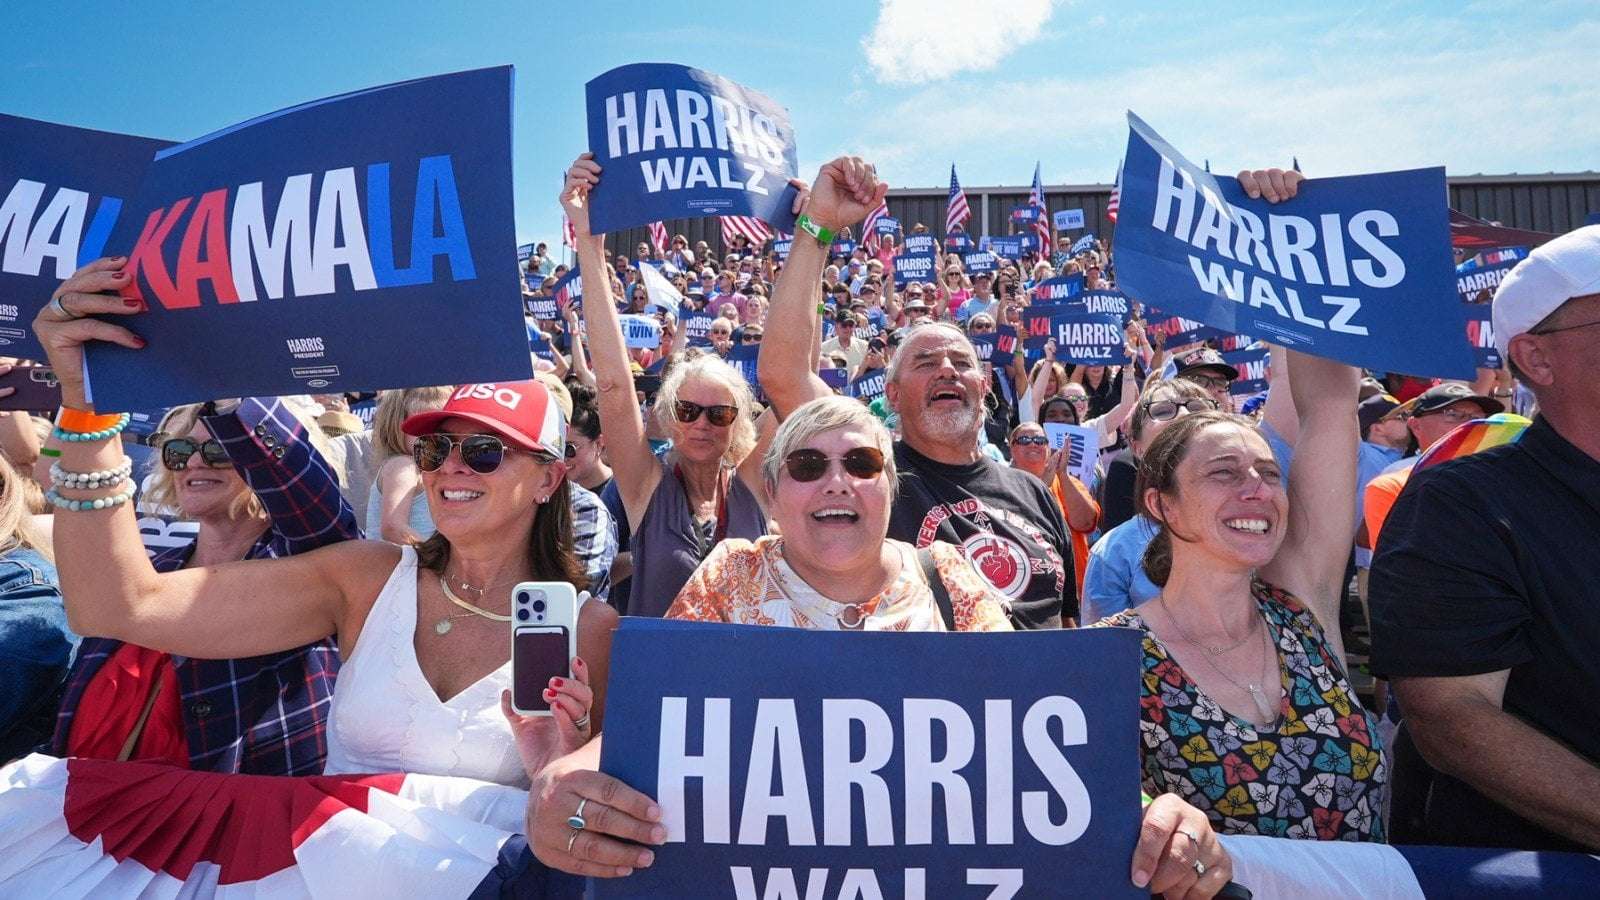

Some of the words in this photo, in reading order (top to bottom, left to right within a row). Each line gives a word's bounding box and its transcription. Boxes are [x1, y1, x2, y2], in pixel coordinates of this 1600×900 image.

[605, 88, 786, 166] HARRIS
[640, 156, 769, 195] WALZ
[1152, 154, 1406, 288] HARRIS
[116, 154, 477, 312] KAMALA
[906, 236, 932, 248] HARRIS
[896, 257, 932, 271] HARRIS
[902, 270, 927, 278] WALZ
[1036, 281, 1080, 299] KAMALA
[1188, 254, 1369, 336] WALZ
[629, 325, 653, 338] WIN
[1058, 323, 1122, 346] HARRIS
[287, 337, 325, 353] HARRIS
[1070, 346, 1112, 359] WALZ
[1066, 433, 1085, 468] WIN
[656, 695, 1092, 847] HARRIS
